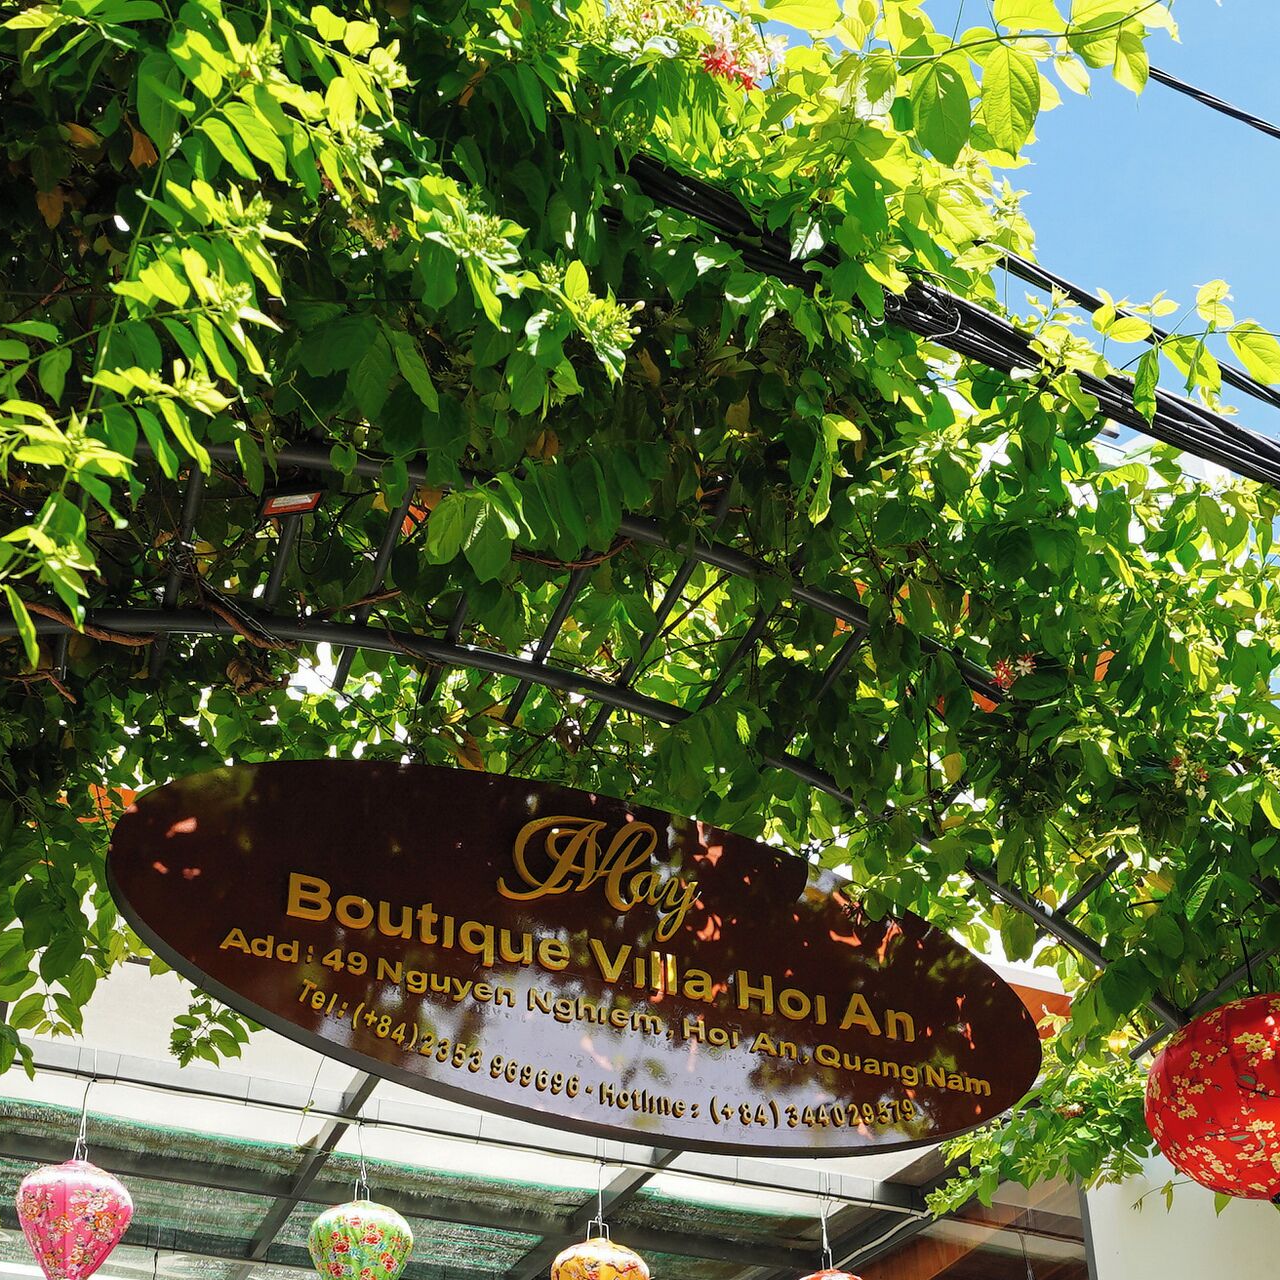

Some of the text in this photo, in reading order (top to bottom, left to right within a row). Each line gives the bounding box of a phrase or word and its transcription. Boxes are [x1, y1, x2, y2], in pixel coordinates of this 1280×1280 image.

[496, 815, 701, 942] May
[285, 872, 917, 1043] Boutique Villa Hoi An
[321, 948, 369, 976] 49
[376, 957, 517, 1009] Nguyen
[682, 1018, 740, 1050] Hoi
[814, 1043, 920, 1088] Quang
[923, 1065, 993, 1098] Nam
[297, 978, 347, 1020] Tel:
[489, 1053, 580, 1100] 969696
